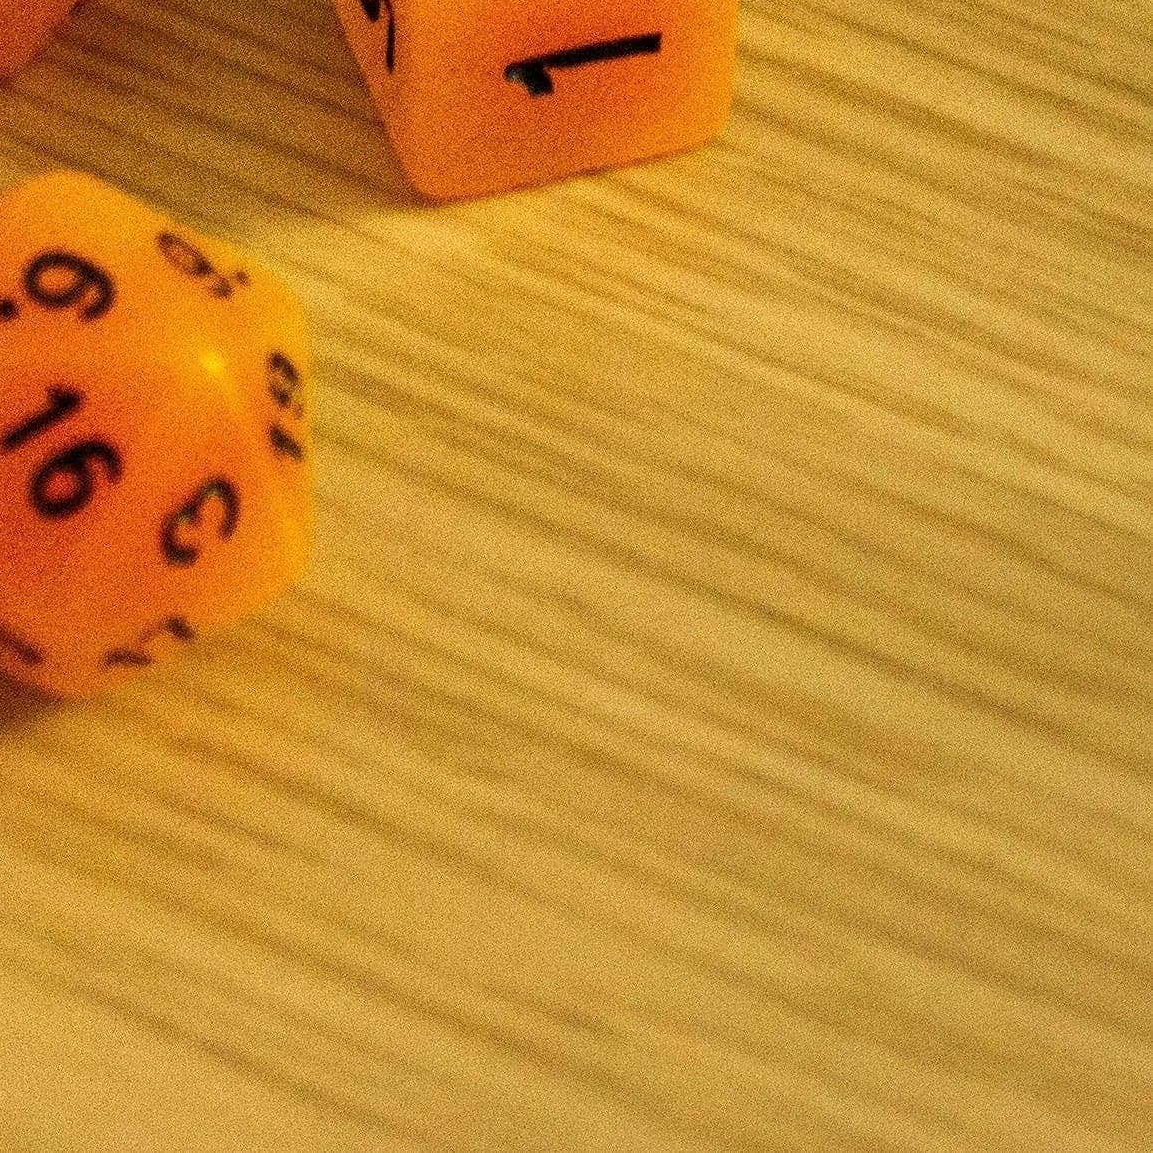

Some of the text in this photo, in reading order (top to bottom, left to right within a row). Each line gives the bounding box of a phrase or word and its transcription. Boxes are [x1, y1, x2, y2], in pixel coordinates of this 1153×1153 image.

[504, 32, 661, 98] 1
[0, 387, 122, 520] 16
[159, 477, 240, 566] 3
